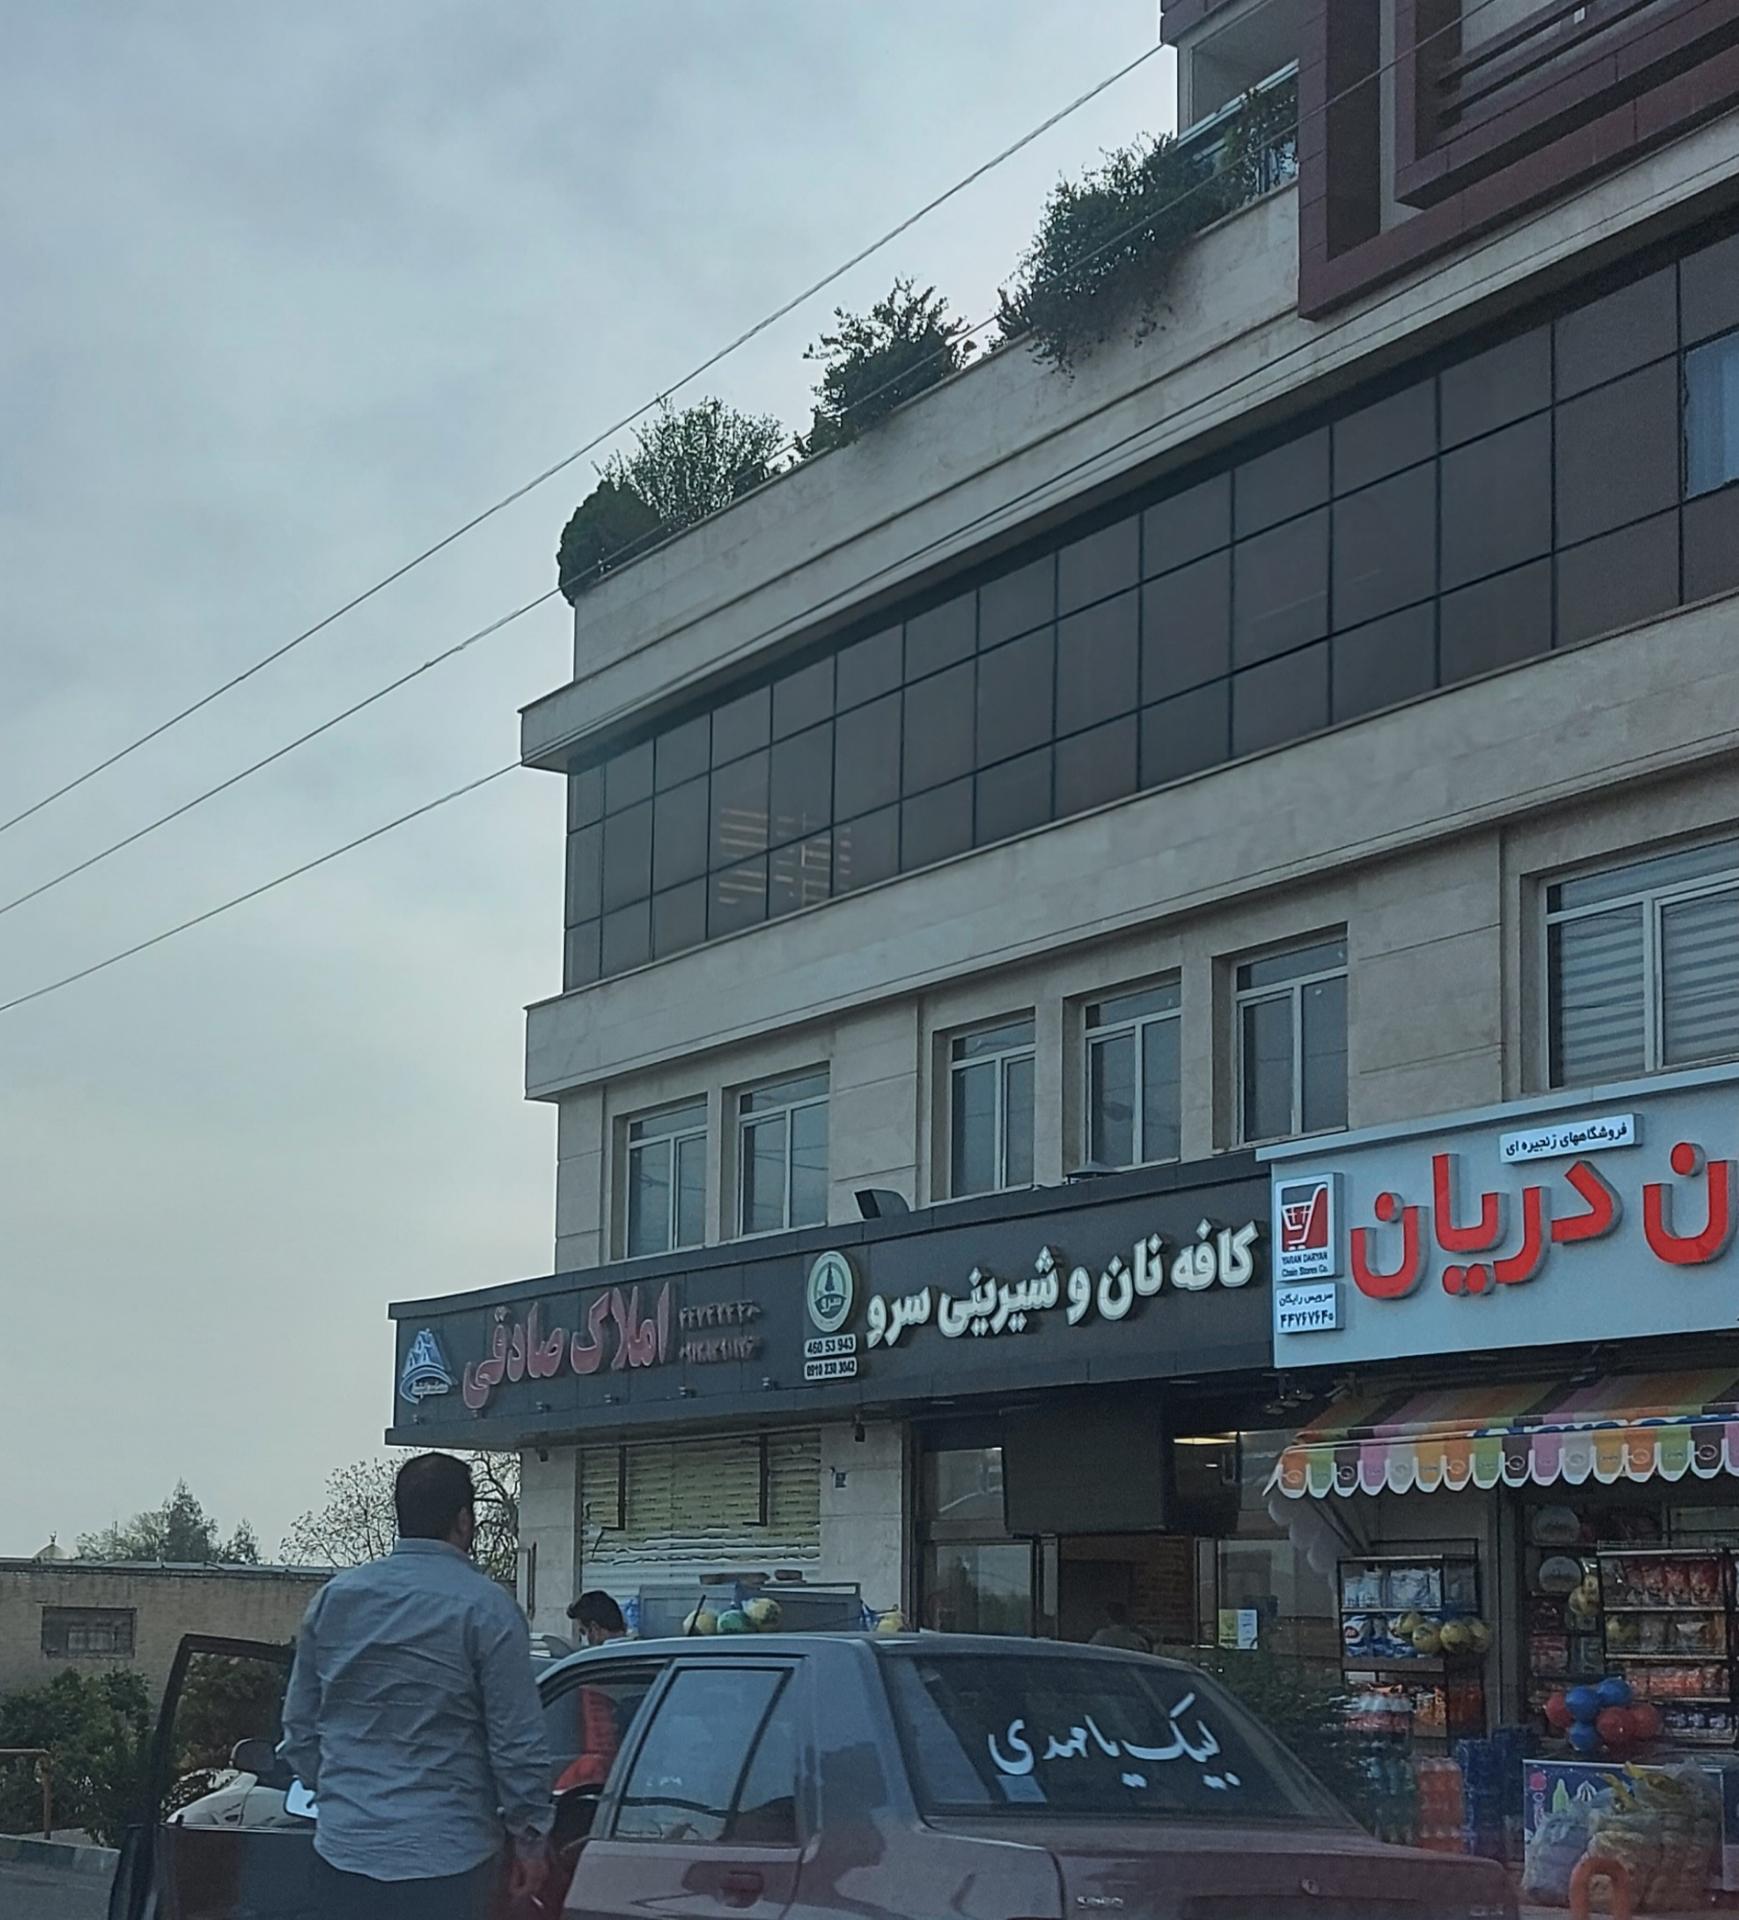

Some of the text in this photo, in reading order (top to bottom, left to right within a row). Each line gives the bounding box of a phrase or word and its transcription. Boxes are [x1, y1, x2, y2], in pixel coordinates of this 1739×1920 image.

[1505, 1140, 1520, 1157] ای
[1521, 1133, 1558, 1154] زنجیره
[865, 1217, 1259, 1349] کافه نان و شیرینی سرو
[1350, 1152, 1621, 1300] دریان
[462, 1280, 671, 1410] املاک صادقی
